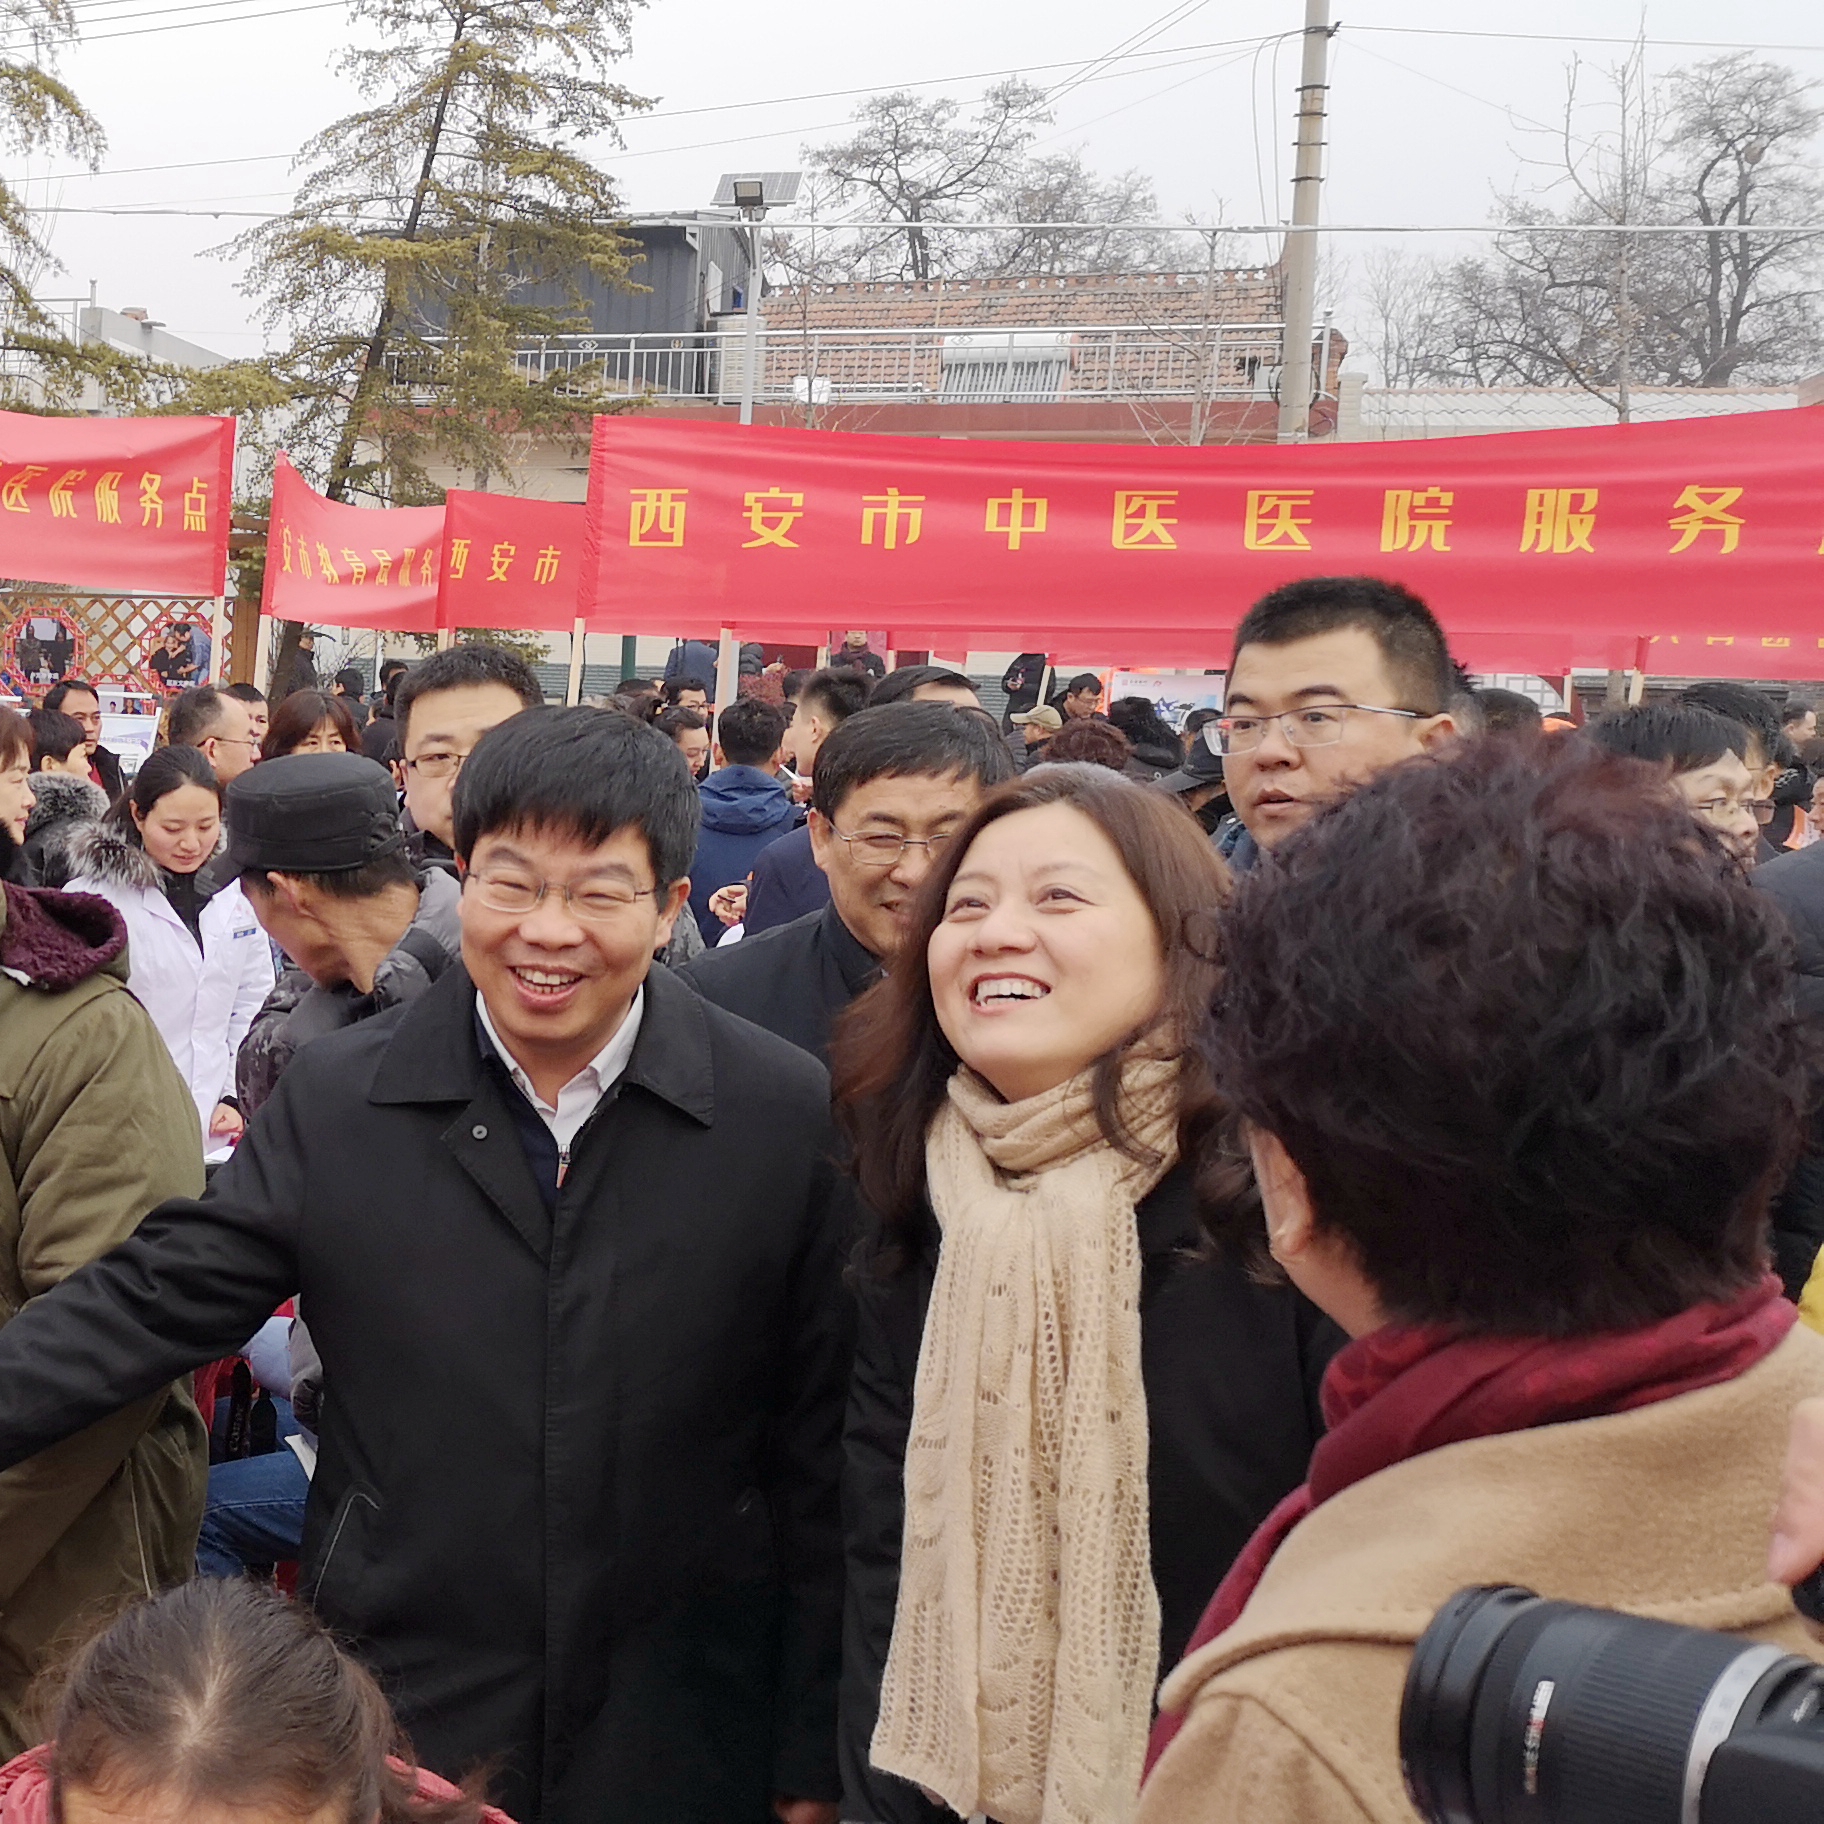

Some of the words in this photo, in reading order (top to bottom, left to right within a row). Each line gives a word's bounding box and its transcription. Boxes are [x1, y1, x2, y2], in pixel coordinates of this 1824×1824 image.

[279, 518, 434, 587] 安市教育局服务
[628, 485, 1824, 555] 西安市中医医院服务
[450, 538, 562, 585] 西安市
